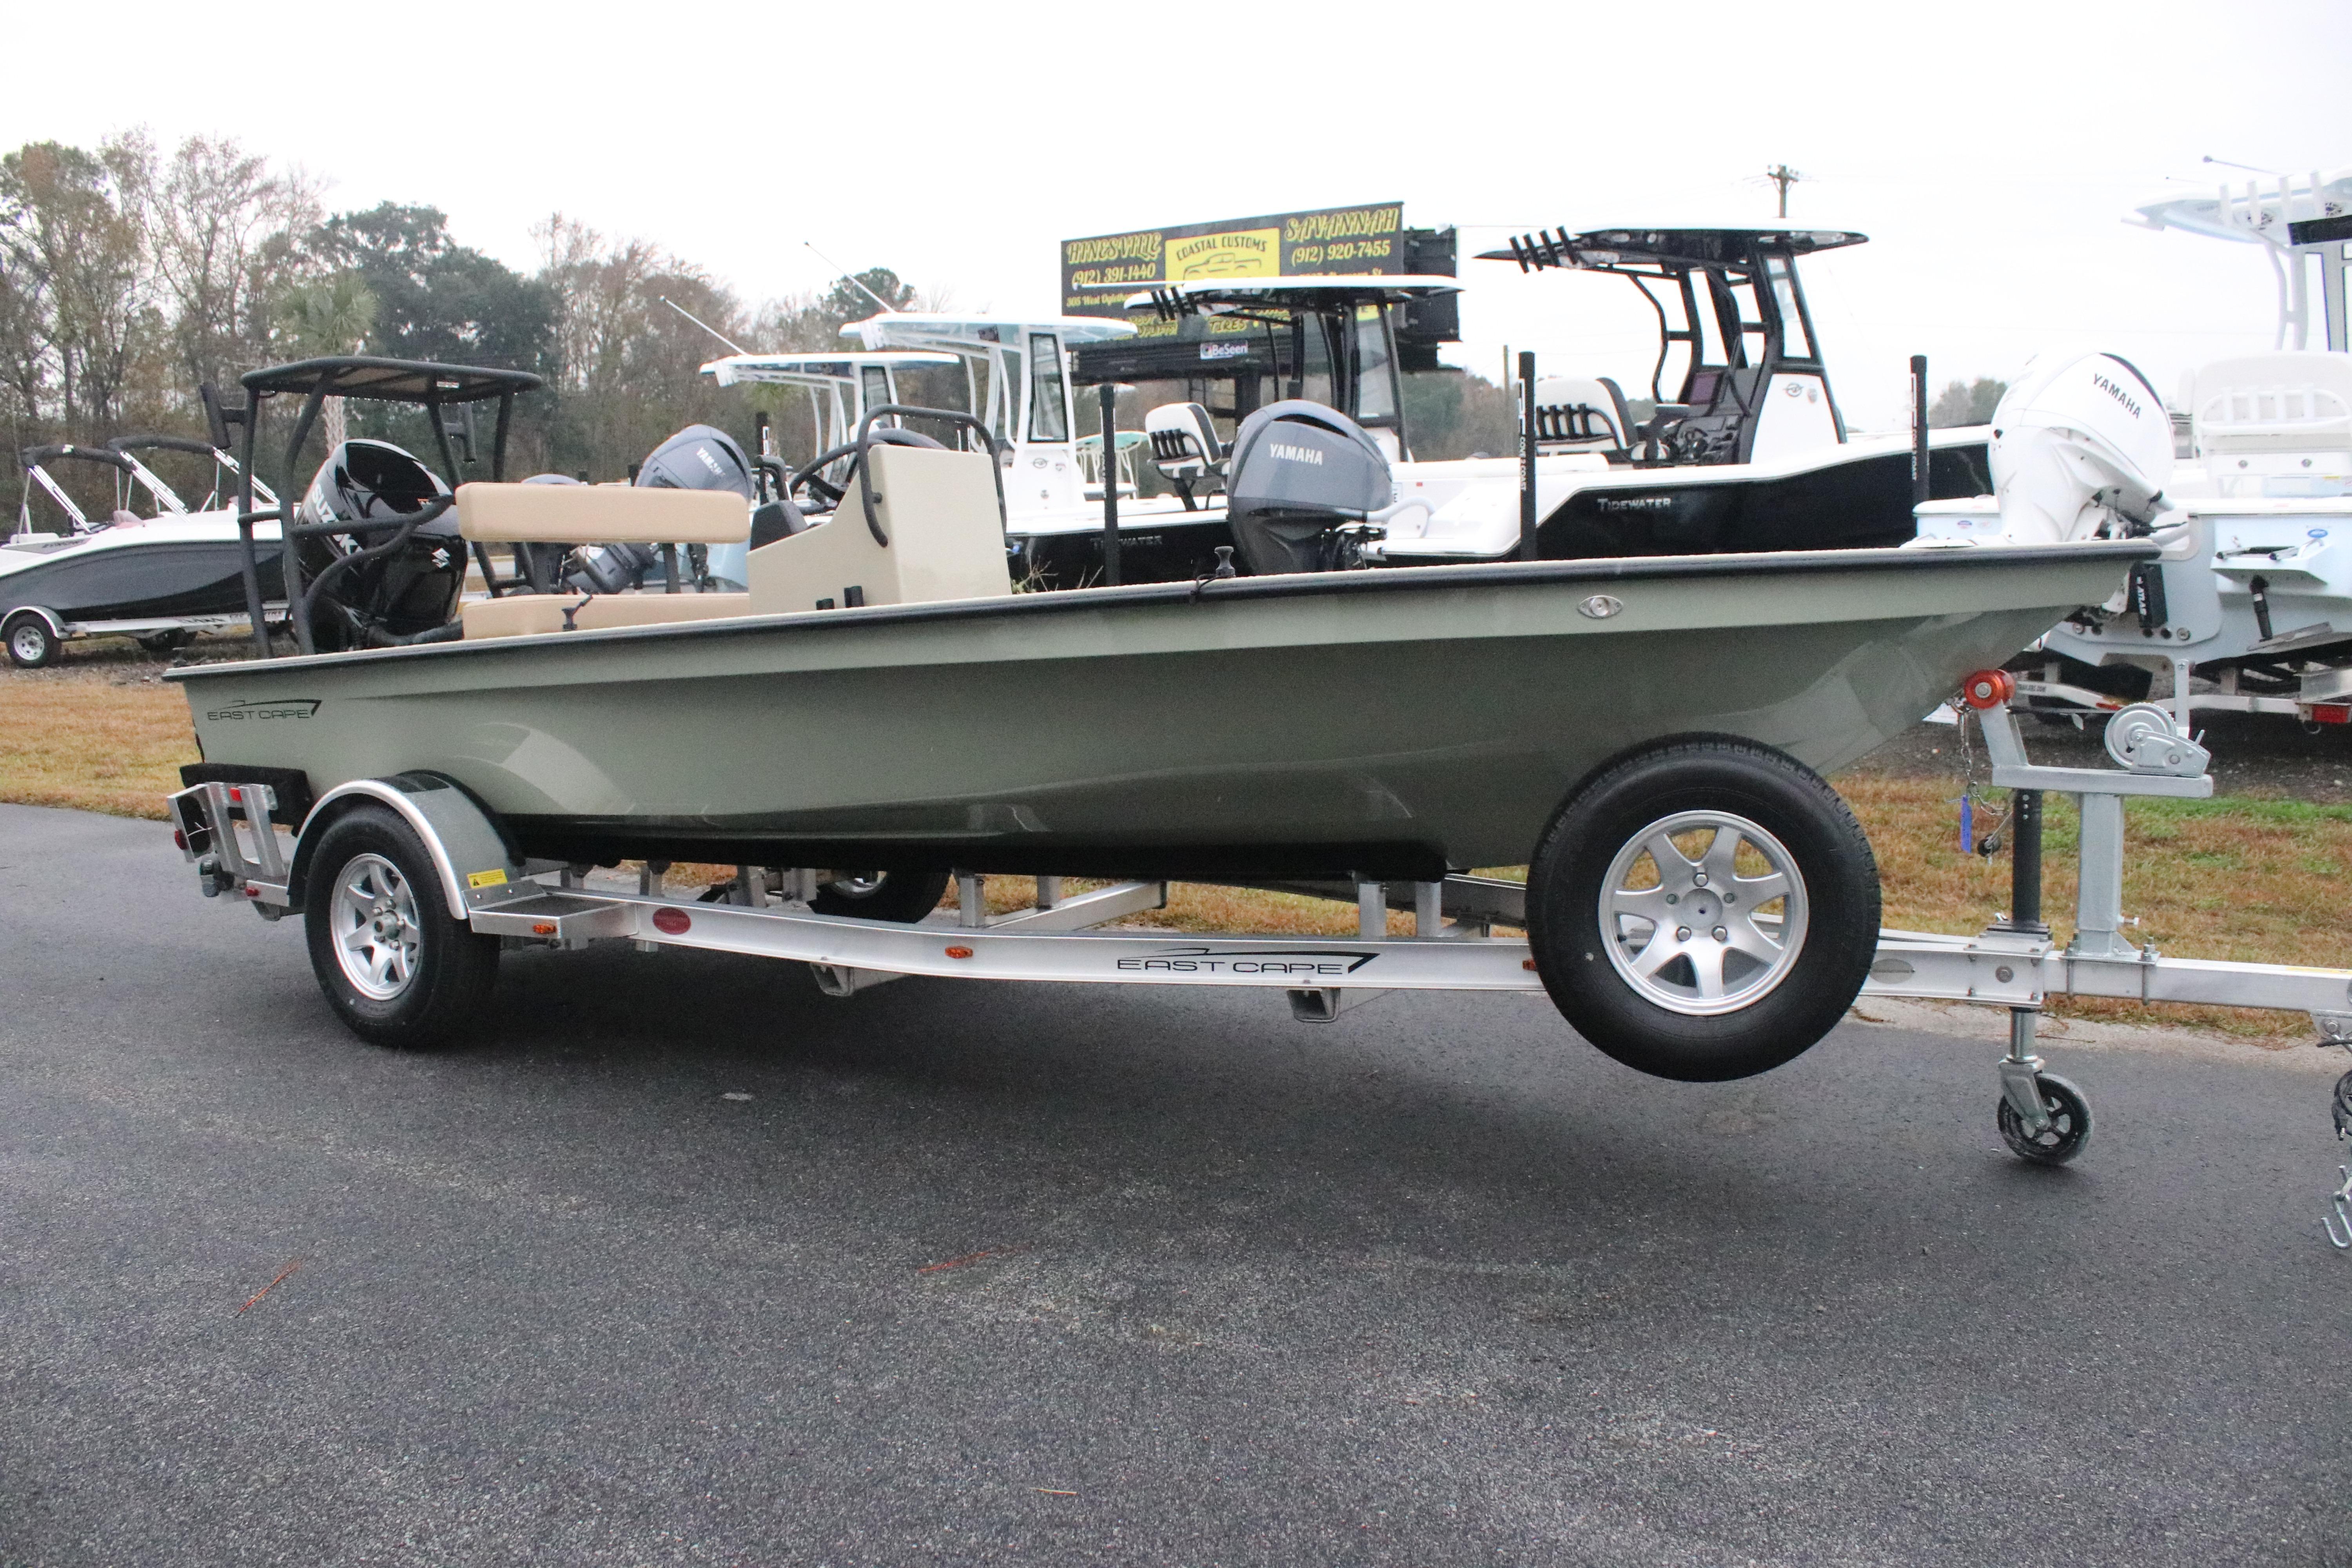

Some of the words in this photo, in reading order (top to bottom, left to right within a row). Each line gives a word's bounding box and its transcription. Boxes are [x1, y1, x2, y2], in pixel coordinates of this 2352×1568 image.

[1285, 207, 1399, 243] SAVANNAH
[1066, 232, 1162, 265] HINESVILLE
[1176, 238, 1217, 261] COASTAL
[1222, 236, 1268, 252] CUSTOMS
[1292, 245, 1324, 267] (912)
[1327, 239, 1391, 261] 920-7455
[1103, 262, 1156, 283] 391-1440
[1212, 343, 1248, 356] BeSeen
[2094, 373, 2141, 419] YAMAHA
[1270, 443, 1323, 465] YAMAHA
[1597, 497, 1671, 512] TIDEWATER
[207, 711, 255, 720] EAST
[259, 710, 310, 719] CAPE
[1117, 959, 1225, 971] EAST
[1233, 962, 1343, 975] CAPE
